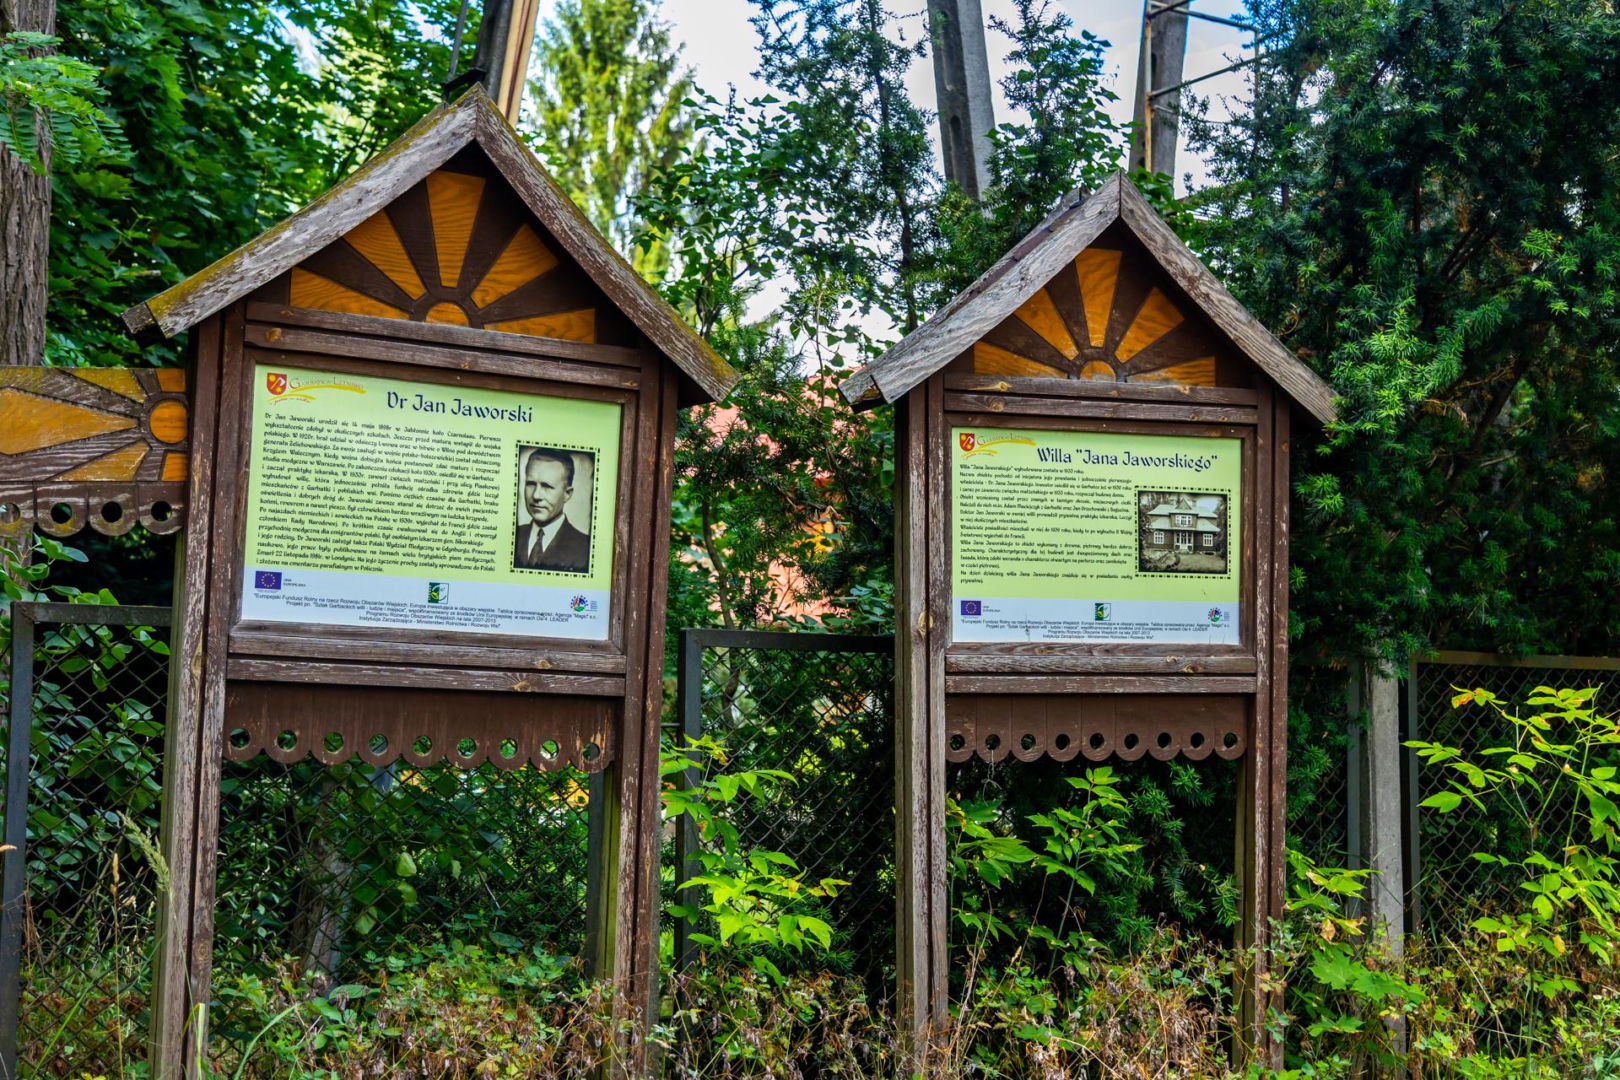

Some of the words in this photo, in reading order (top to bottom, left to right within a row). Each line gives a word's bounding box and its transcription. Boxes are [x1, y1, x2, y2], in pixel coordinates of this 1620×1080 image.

[387, 391, 408, 409] Dr
[412, 394, 446, 414] Jan
[450, 398, 533, 423] Jaworski
[1037, 447, 1072, 464] Willa
[1076, 449, 1118, 466] "Jana
[1122, 451, 1218, 473] Jaworskiego"
